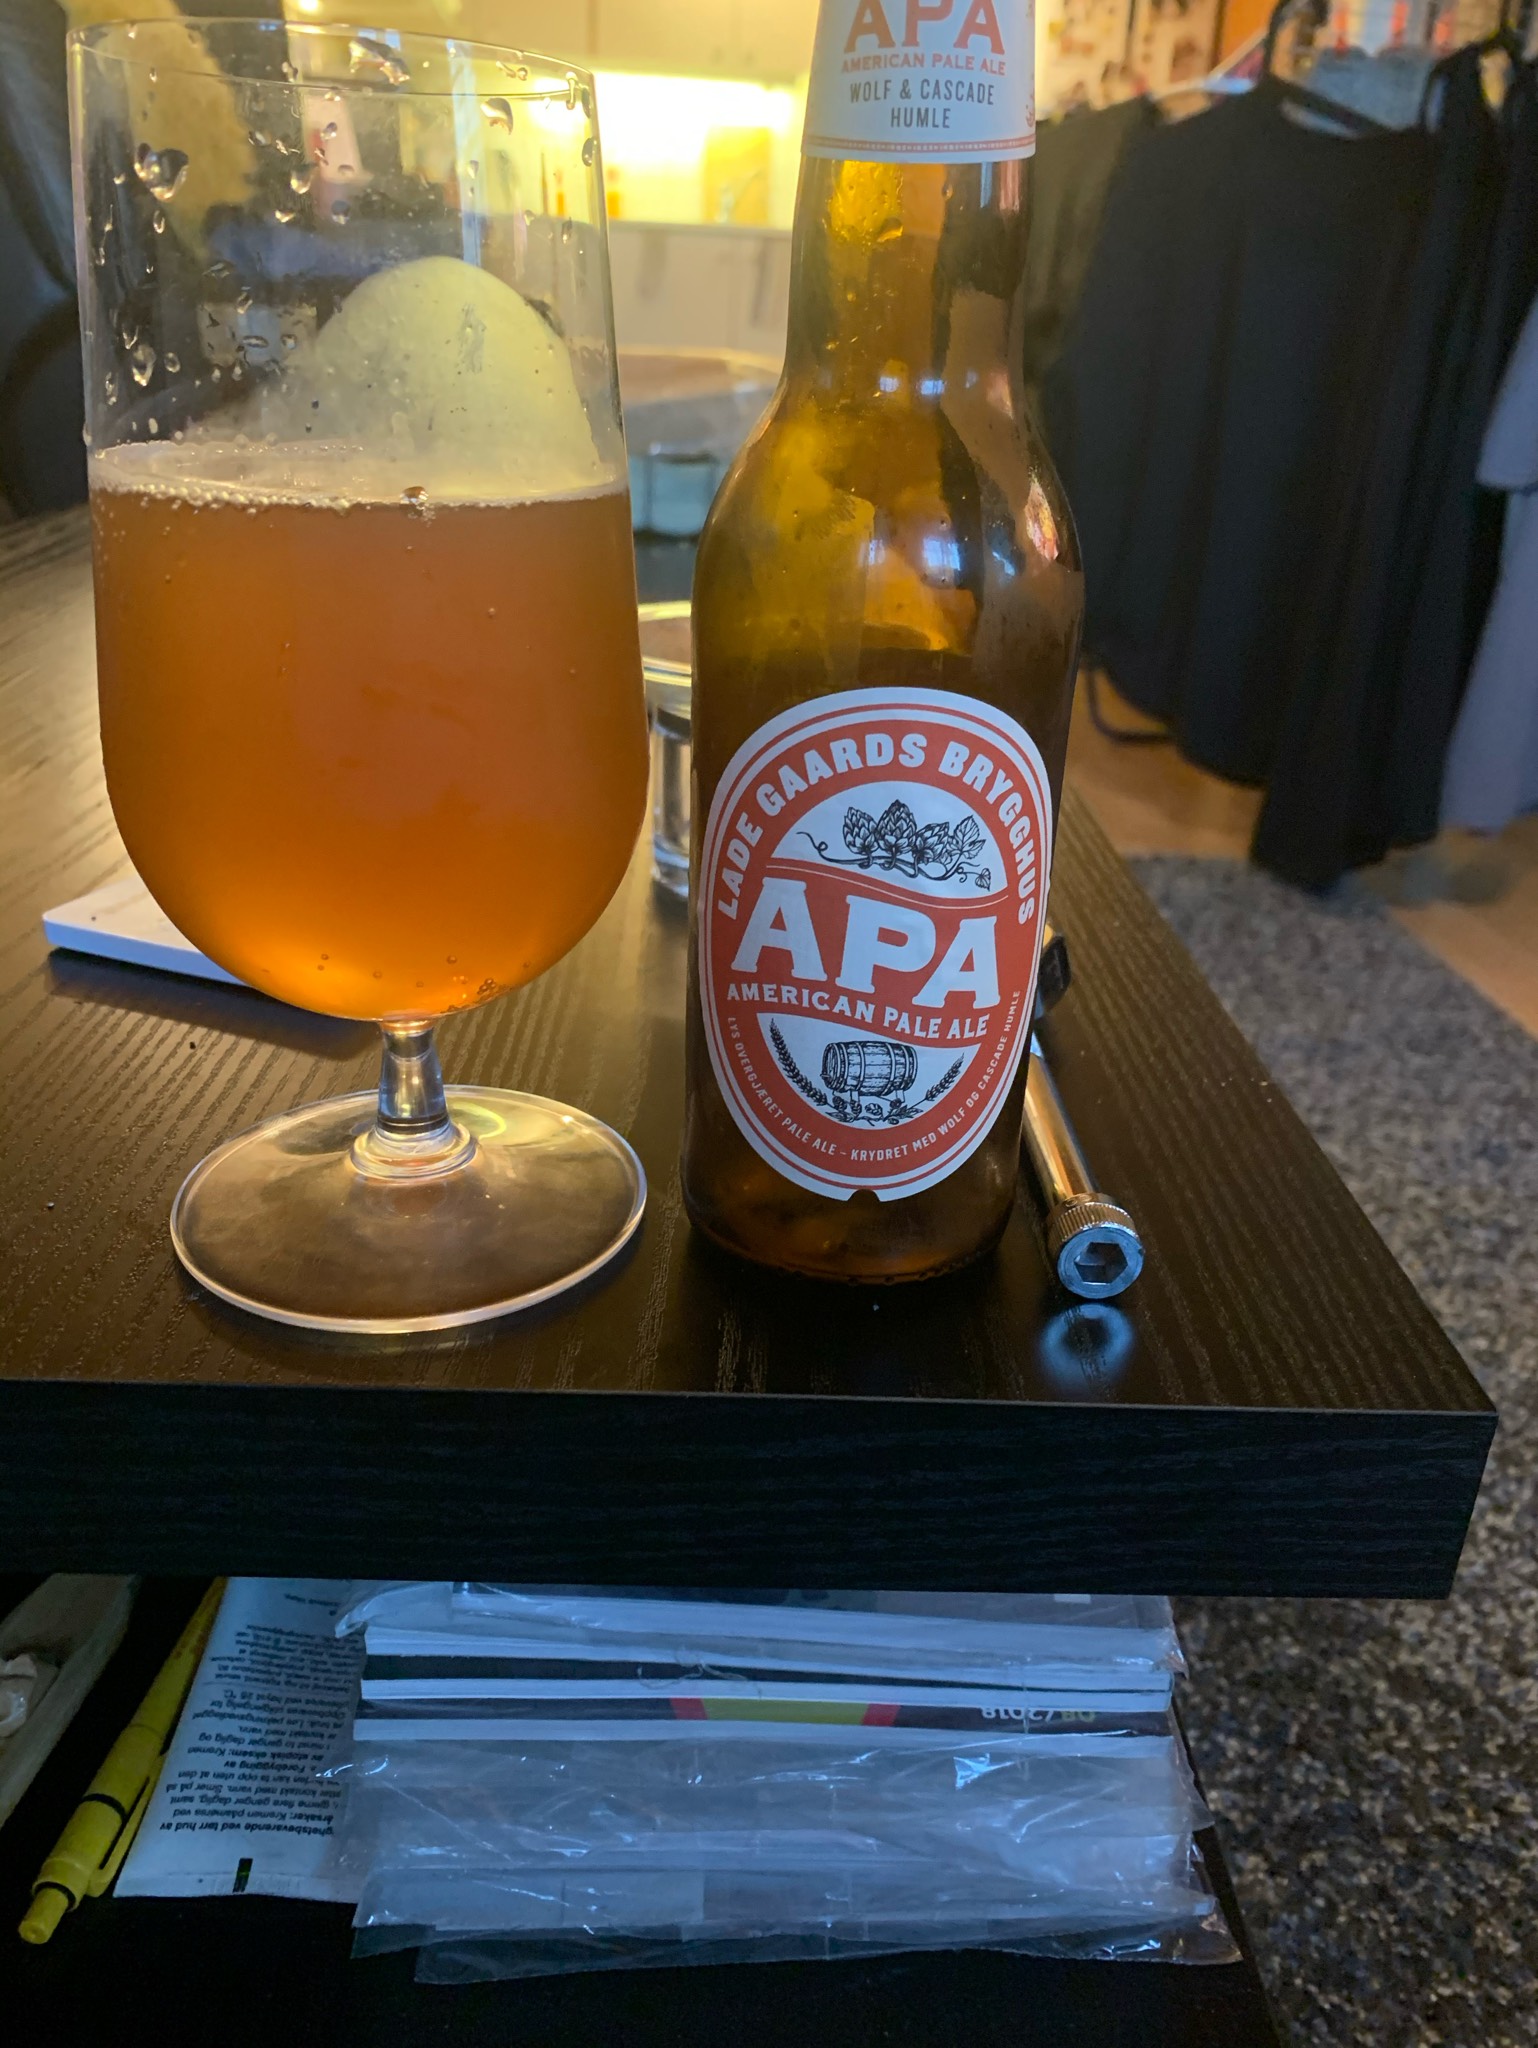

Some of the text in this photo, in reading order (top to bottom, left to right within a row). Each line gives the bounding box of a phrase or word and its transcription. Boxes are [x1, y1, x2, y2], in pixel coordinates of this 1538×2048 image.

[843, 0, 1005, 55] APA
[841, 53, 1006, 76] AMERICAN PALE ALE
[850, 78, 995, 105] WOLF & CASCADE
[890, 107, 952, 129] HUMLE
[718, 733, 1034, 925] LADE GAARDS BRYGGHUS
[731, 877, 1001, 1009] APA
[727, 983, 990, 1039] AMERICAN PALE ALE
[727, 1017, 740, 1039] LYS
[734, 1043, 784, 1118] OVERGJÆRET
[782, 1117, 812, 1144] PALE
[812, 1139, 837, 1155] ALE
[850, 1144, 908, 1161] KRYDRET
[912, 1132, 937, 1152] MED
[937, 1108, 966, 1136] WOLF
[965, 1091, 980, 1108] OG
[978, 1036, 1008, 1091] CASCADE
[1004, 990, 1020, 1032] HUMLE
[199, 1733, 212, 1741] og
[214, 1734, 245, 1745] daglig
[229, 1749, 267, 1759] eksem:
[224, 1761, 236, 1769] av
[240, 1761, 305, 1773] Forebygging
[180, 1782, 193, 1792] på
[254, 1787, 277, 1796] med
[235, 1797, 270, 1807] ganger
[173, 1809, 191, 1818] ved
[248, 1810, 287, 1821] Kremen
[160, 1822, 172, 1830] av
[175, 1822, 196, 1832] hud
[220, 1822, 241, 1832] ved
